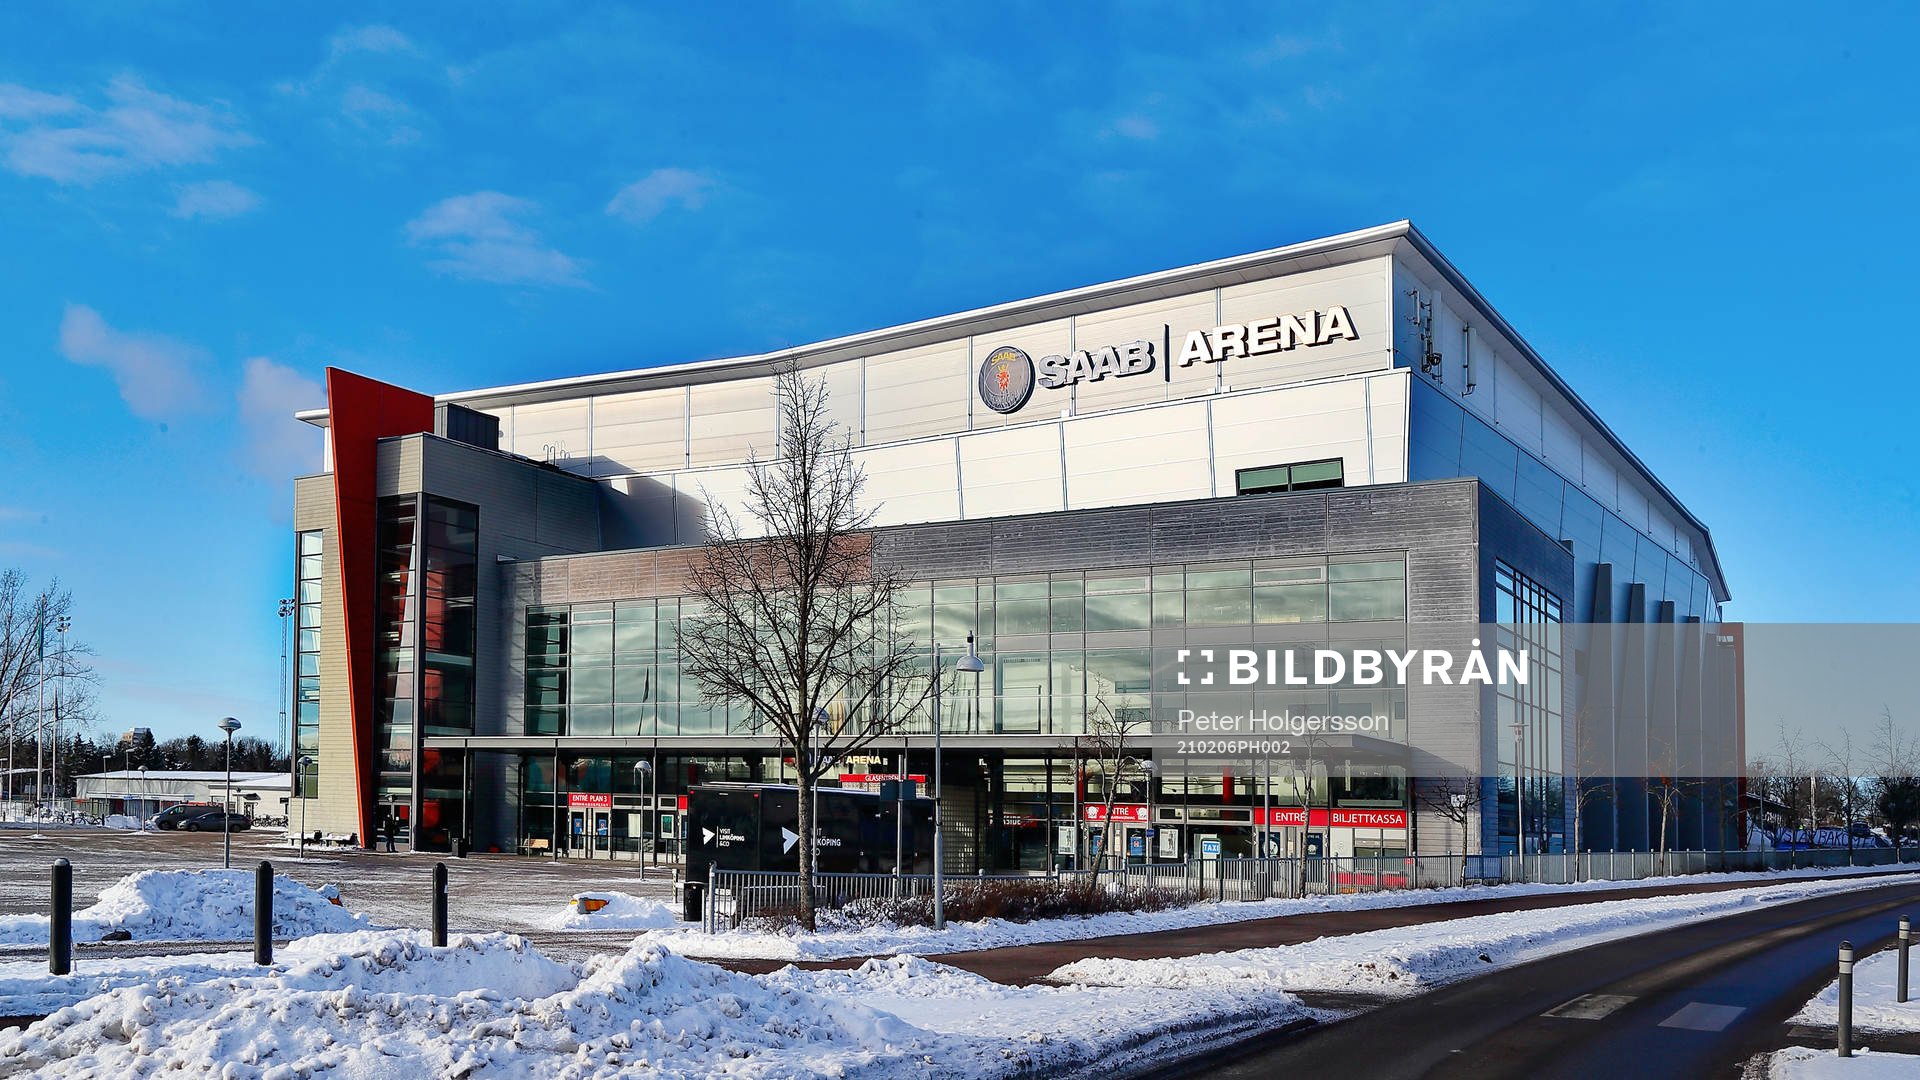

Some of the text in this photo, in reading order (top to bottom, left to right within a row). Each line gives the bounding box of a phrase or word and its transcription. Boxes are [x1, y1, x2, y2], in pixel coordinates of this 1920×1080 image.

[1038, 305, 1360, 389] SAAB ARENA
[846, 755, 882, 764] ARENA
[572, 794, 588, 802] ENTRÉ
[1111, 806, 1129, 815] NTRÉ
[1332, 812, 1403, 824] BILJETTKASSA
[1203, 843, 1219, 852] TAXI
